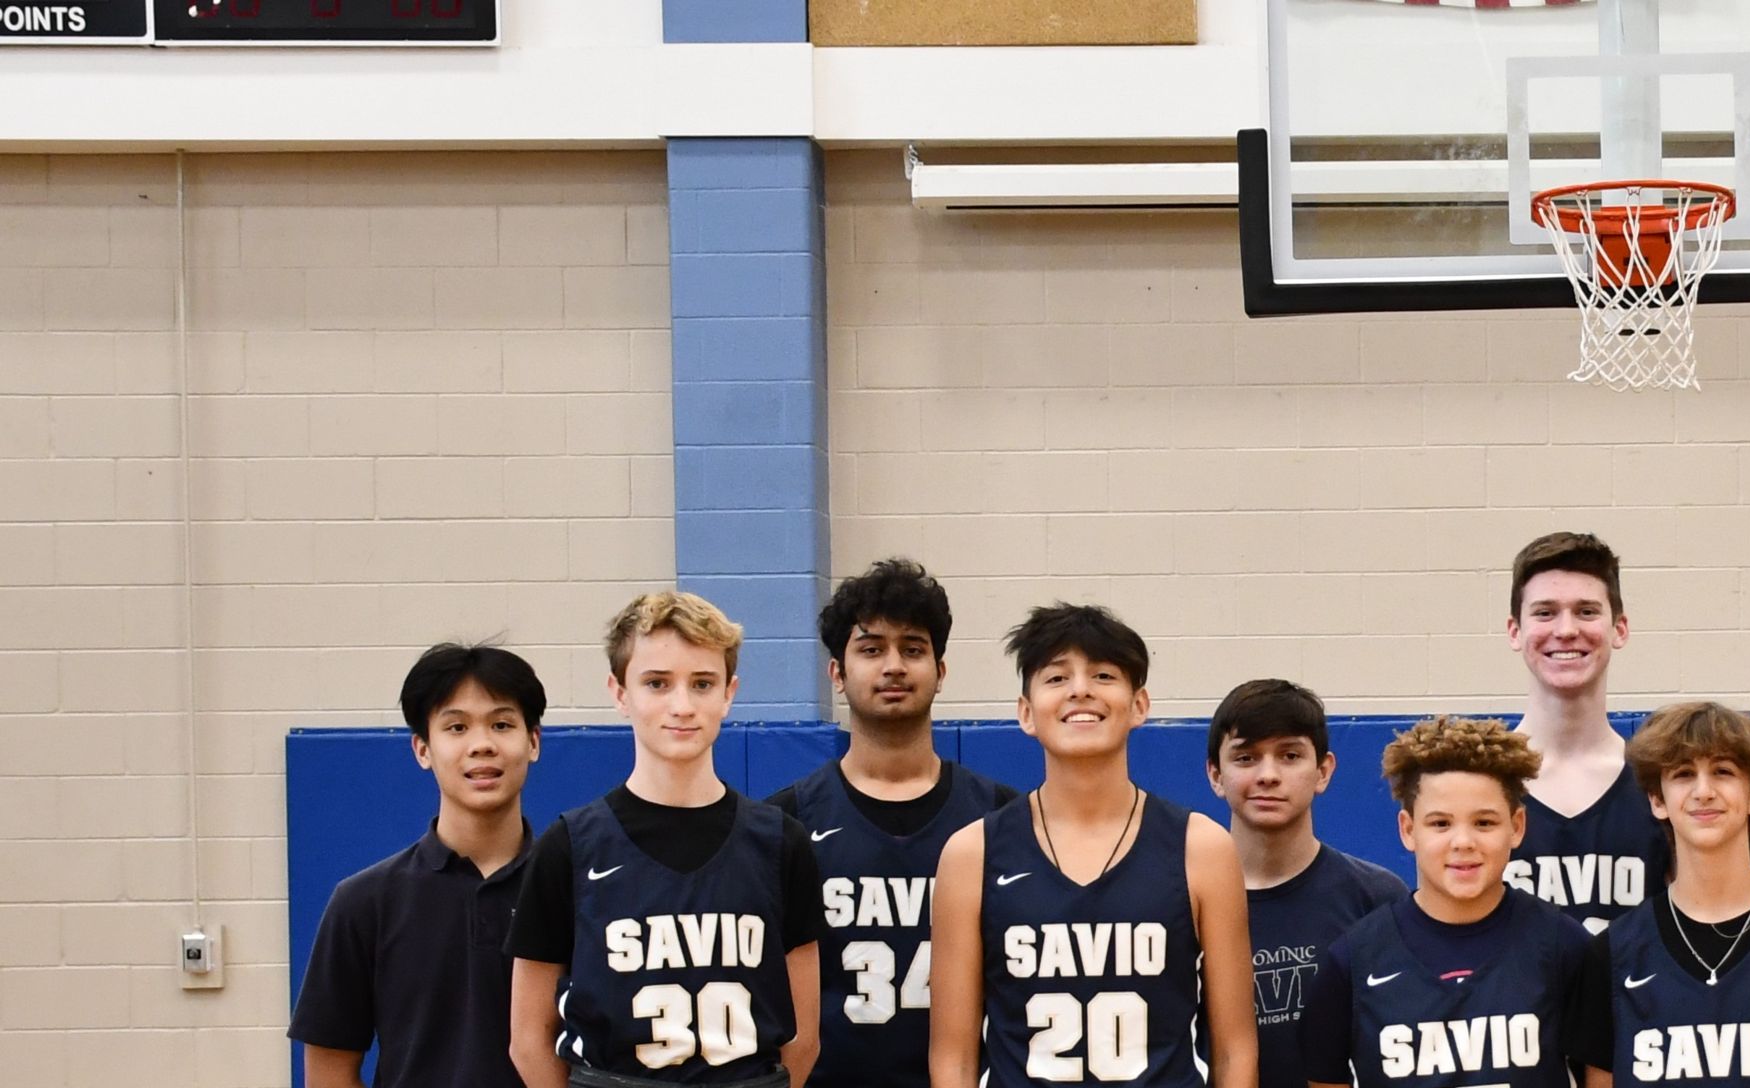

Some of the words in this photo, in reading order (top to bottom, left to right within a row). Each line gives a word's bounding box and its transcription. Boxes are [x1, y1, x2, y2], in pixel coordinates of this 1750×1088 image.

[0, 5, 86, 32] OINTS
[822, 876, 936, 928] SAV
[1502, 853, 1645, 906] SAVIO
[605, 912, 765, 973] SAVIO
[1004, 922, 1167, 978] SAVIO
[1252, 945, 1316, 966] OMINIC
[632, 981, 758, 1069] 30
[1025, 991, 1149, 1082] 20
[1258, 1013, 1290, 1026] HIGH
[1379, 1013, 1540, 1079] SAVIO
